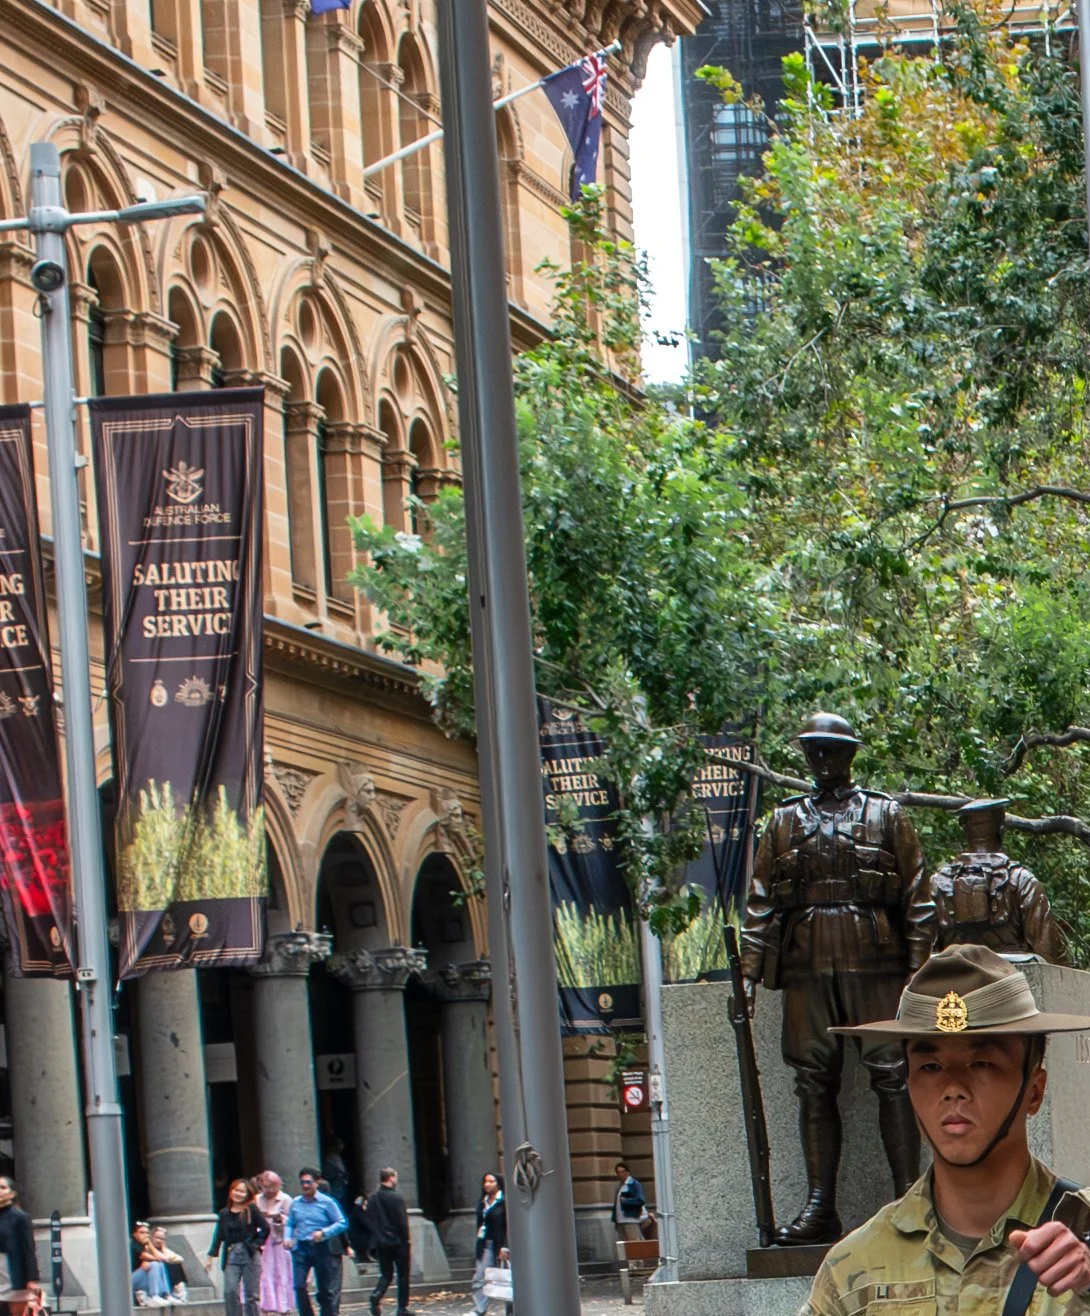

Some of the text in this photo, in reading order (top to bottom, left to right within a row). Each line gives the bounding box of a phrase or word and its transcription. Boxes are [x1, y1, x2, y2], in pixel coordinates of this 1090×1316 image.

[154, 503, 220, 516] AUSTRALIAN
[143, 512, 231, 527] DEFENCE FORCE
[154, 586, 230, 611] THEIR
[550, 774, 599, 792] THEIR
[545, 790, 610, 810] SVICE
